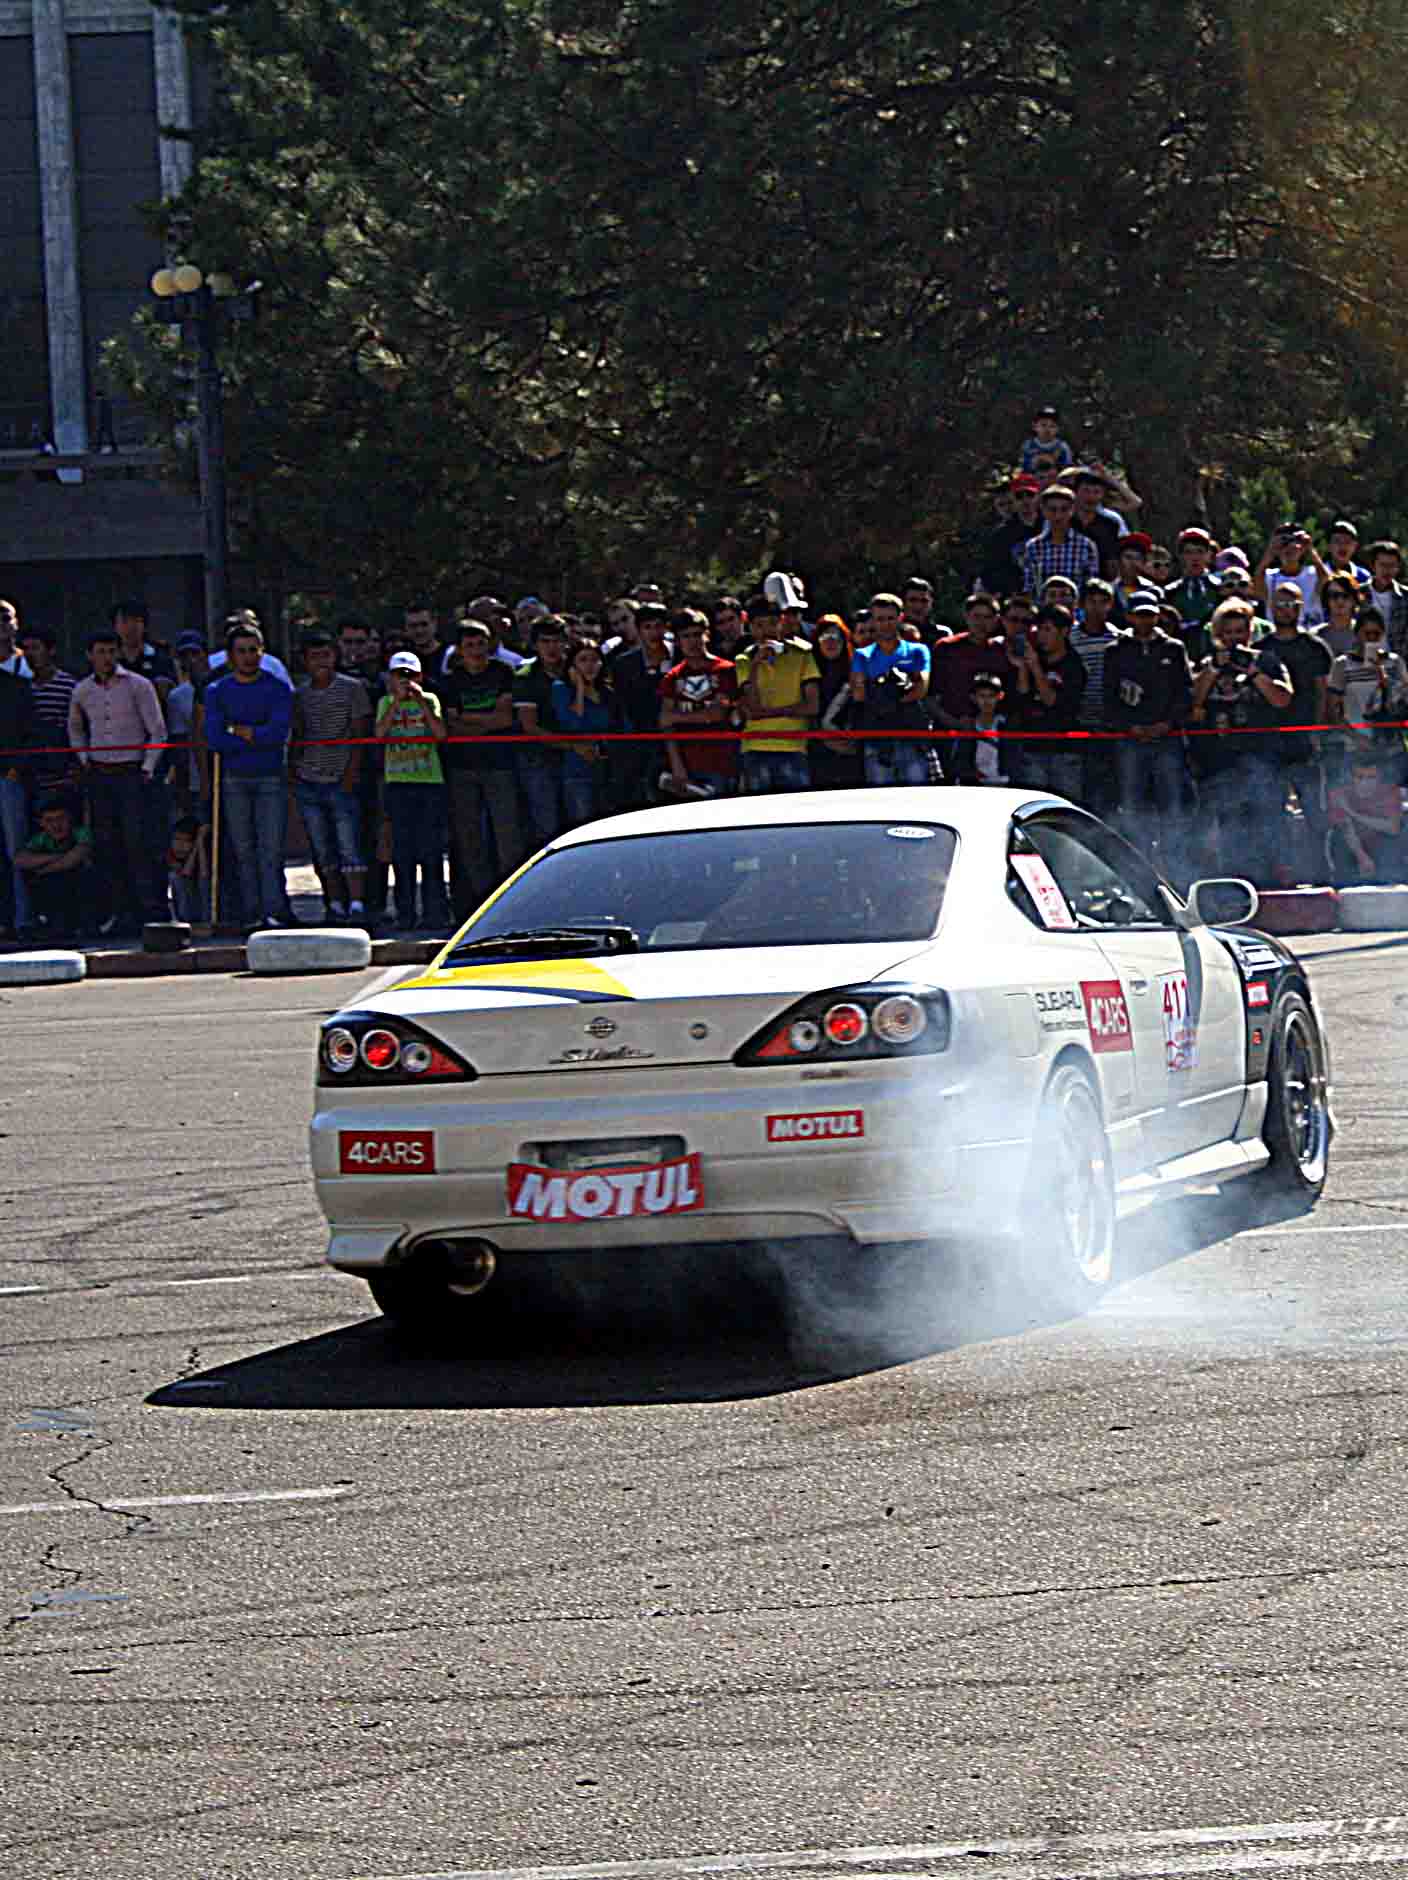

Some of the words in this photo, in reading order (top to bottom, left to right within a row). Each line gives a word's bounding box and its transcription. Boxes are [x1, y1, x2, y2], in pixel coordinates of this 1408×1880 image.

[771, 1115, 859, 1137] MOTUL
[348, 1141, 425, 1165] 4CARS
[517, 1163, 697, 1218] MOTUL
